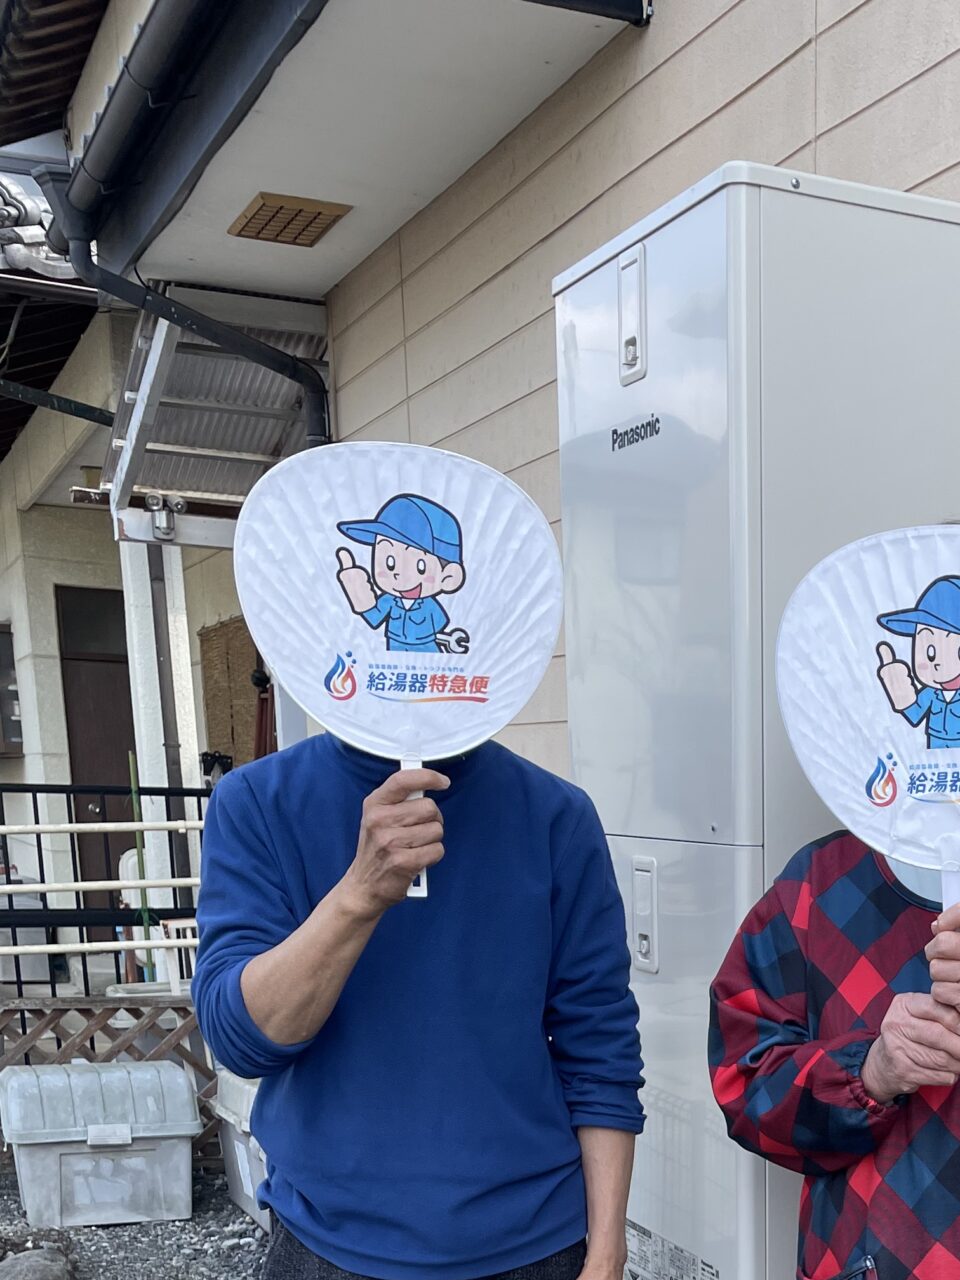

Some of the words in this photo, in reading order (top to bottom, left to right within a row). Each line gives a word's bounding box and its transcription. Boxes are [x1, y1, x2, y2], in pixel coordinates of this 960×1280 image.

[611, 413, 660, 452] Panasonic
[366, 672, 490, 694] 給湯器特急便
